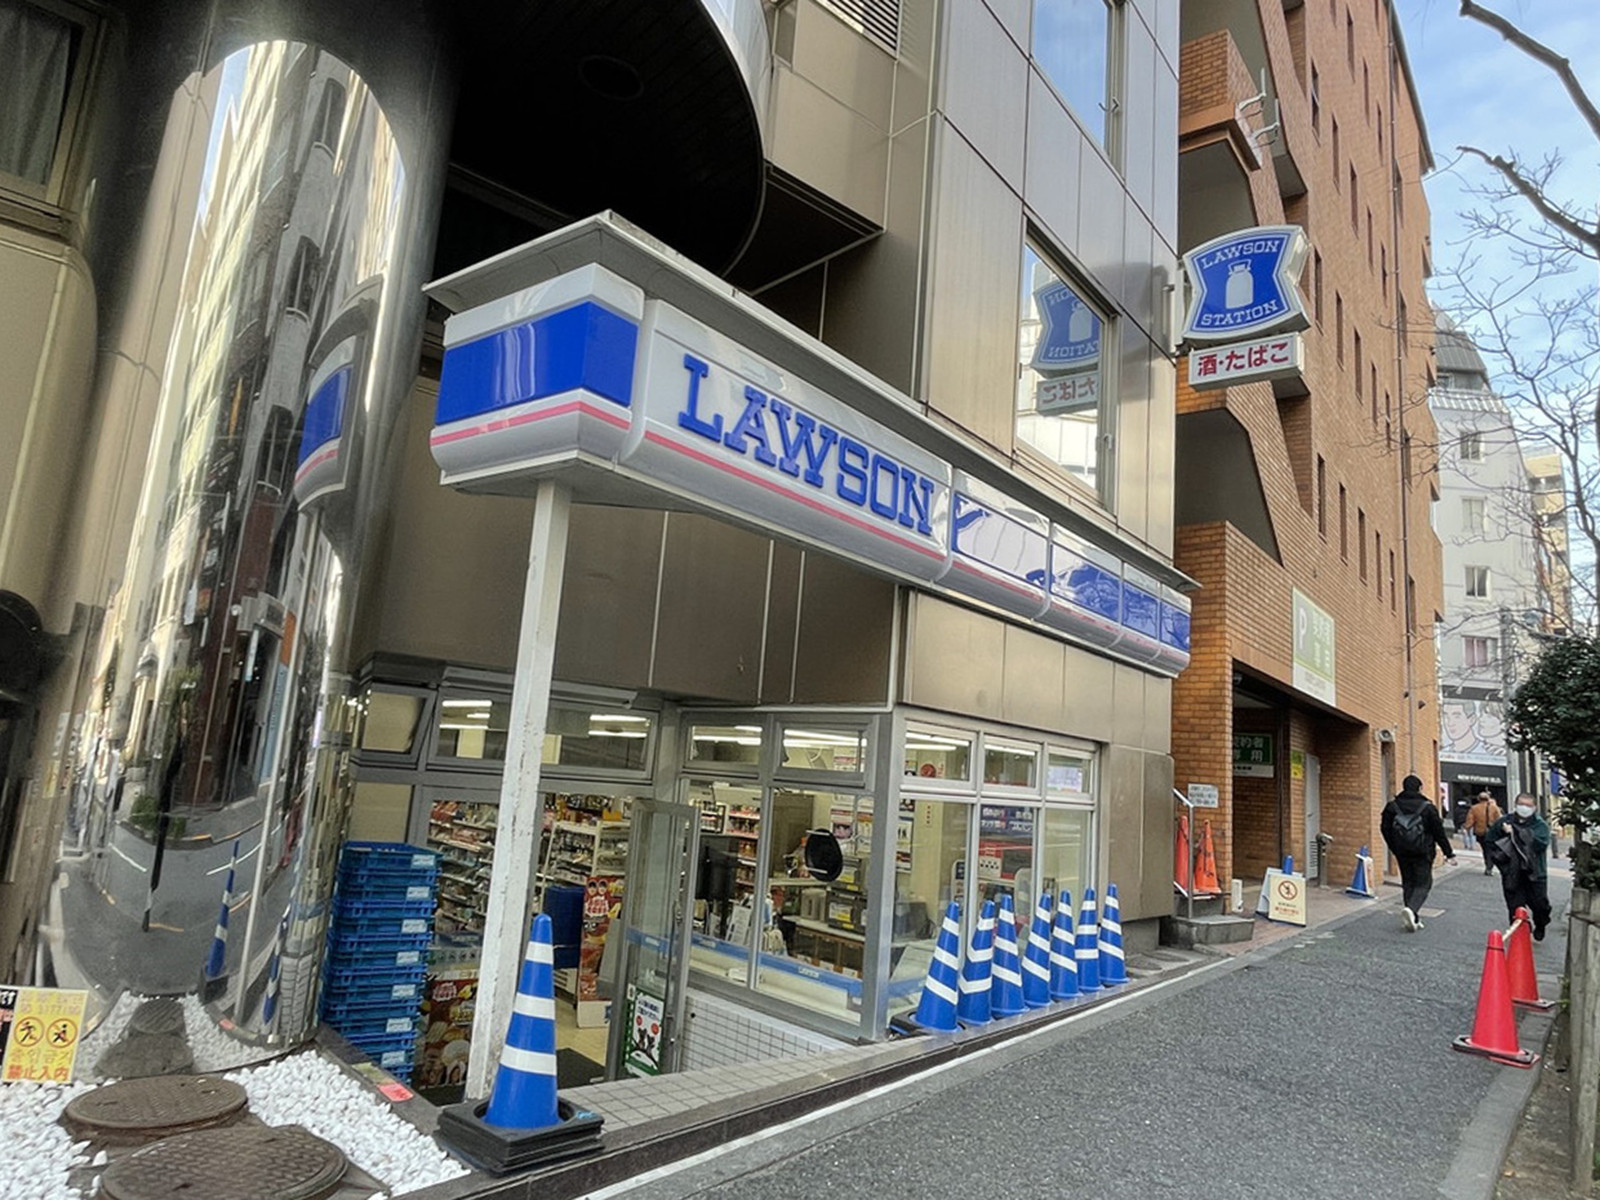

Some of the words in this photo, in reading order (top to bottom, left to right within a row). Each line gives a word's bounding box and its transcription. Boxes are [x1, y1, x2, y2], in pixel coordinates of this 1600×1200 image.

[1201, 239, 1280, 270] LAWSON
[1201, 299, 1279, 326] STATION
[1198, 342, 1289, 376] 酒・たばこ
[678, 353, 934, 536] LAWSON
